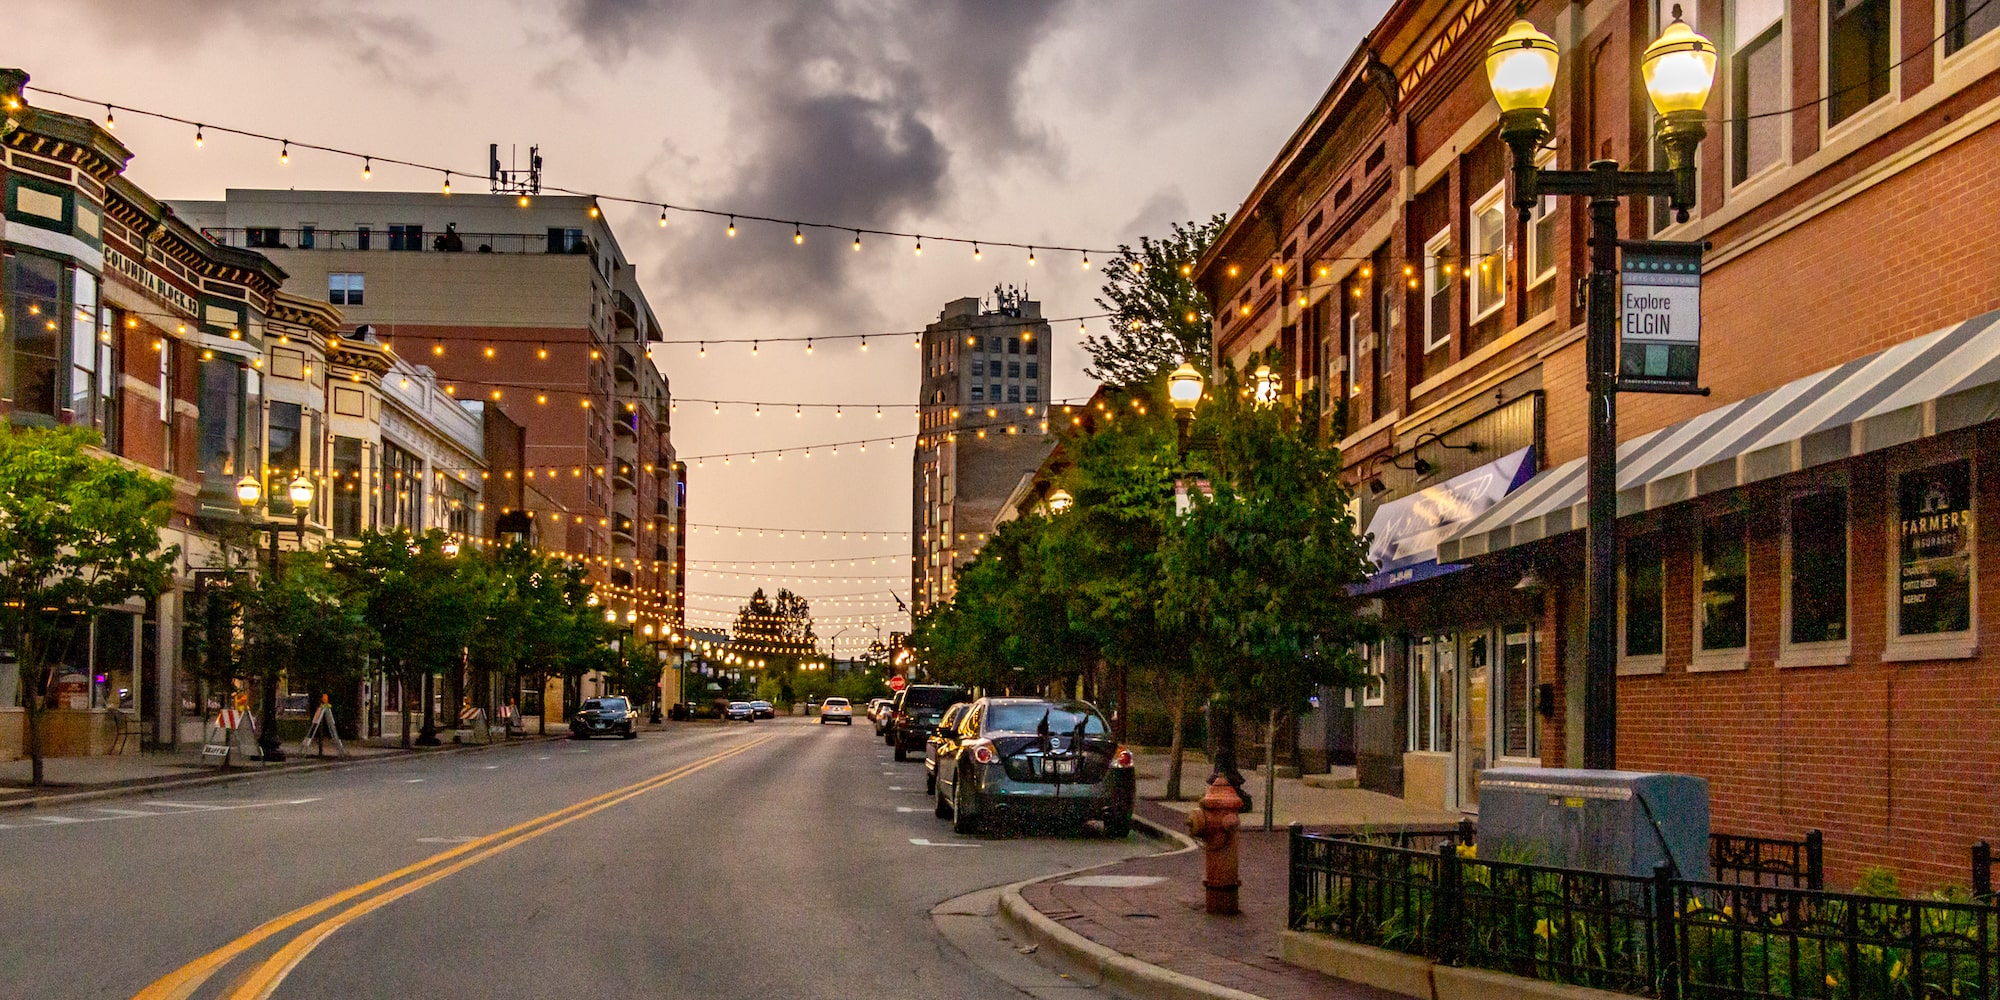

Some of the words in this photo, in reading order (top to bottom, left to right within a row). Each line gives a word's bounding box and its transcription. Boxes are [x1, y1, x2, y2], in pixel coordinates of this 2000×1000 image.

[104, 246, 154, 290] COLUMBIA
[1658, 276, 1697, 284] CULTURE
[1626, 293, 1671, 313] Explore
[1627, 313, 1670, 335] ELGIN
[1901, 509, 1970, 536] FARMERS
[1912, 533, 1957, 549] INSURANCE
[1902, 593, 1927, 604] AGENCY
